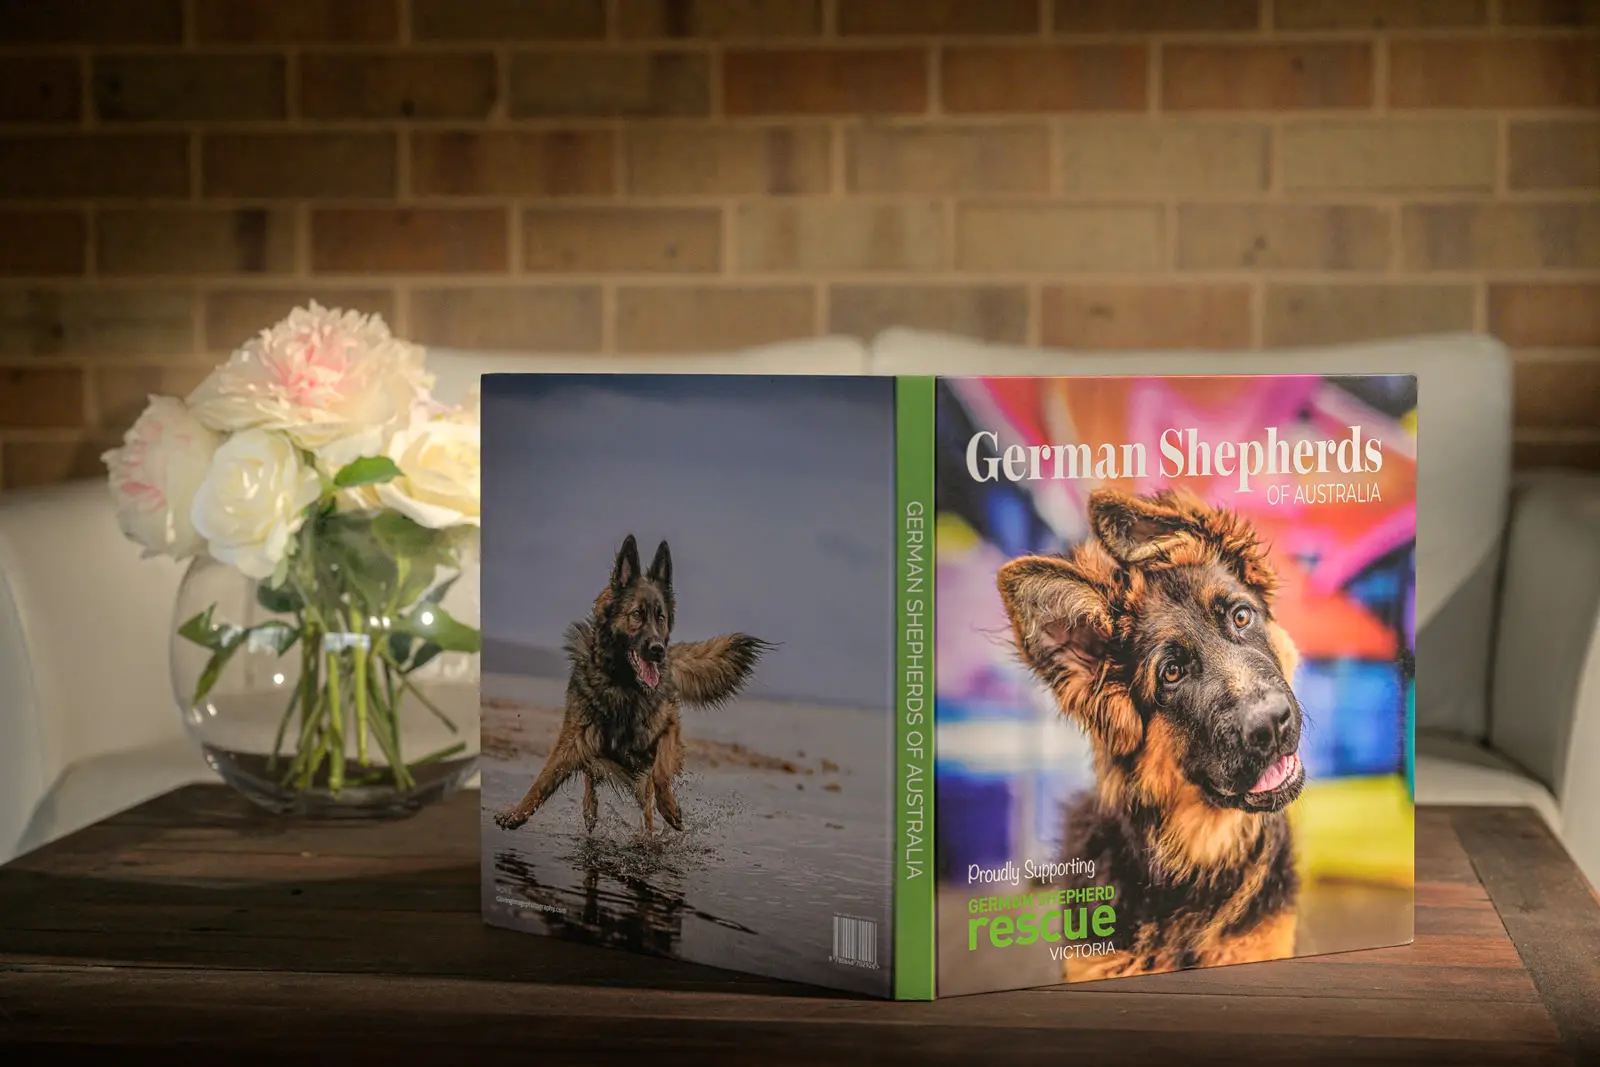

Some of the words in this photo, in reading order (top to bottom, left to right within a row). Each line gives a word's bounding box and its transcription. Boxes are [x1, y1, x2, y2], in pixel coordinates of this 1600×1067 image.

[966, 431, 1150, 483] German
[1159, 425, 1383, 493] Shepherds
[1267, 484, 1290, 505] OF
[1293, 482, 1382, 505] AUSTRALIA
[906, 501, 924, 593] GERMAN
[906, 599, 924, 725] SHEPHERDS
[906, 731, 924, 759] OF
[906, 763, 924, 880] AUSTRALIA
[968, 861, 1020, 886] Proudly
[1024, 857, 1096, 884] Supporting
[1037, 885, 1115, 907] SHEPHERD
[968, 904, 1117, 951] rescue
[1049, 941, 1116, 961] VICTORIA
